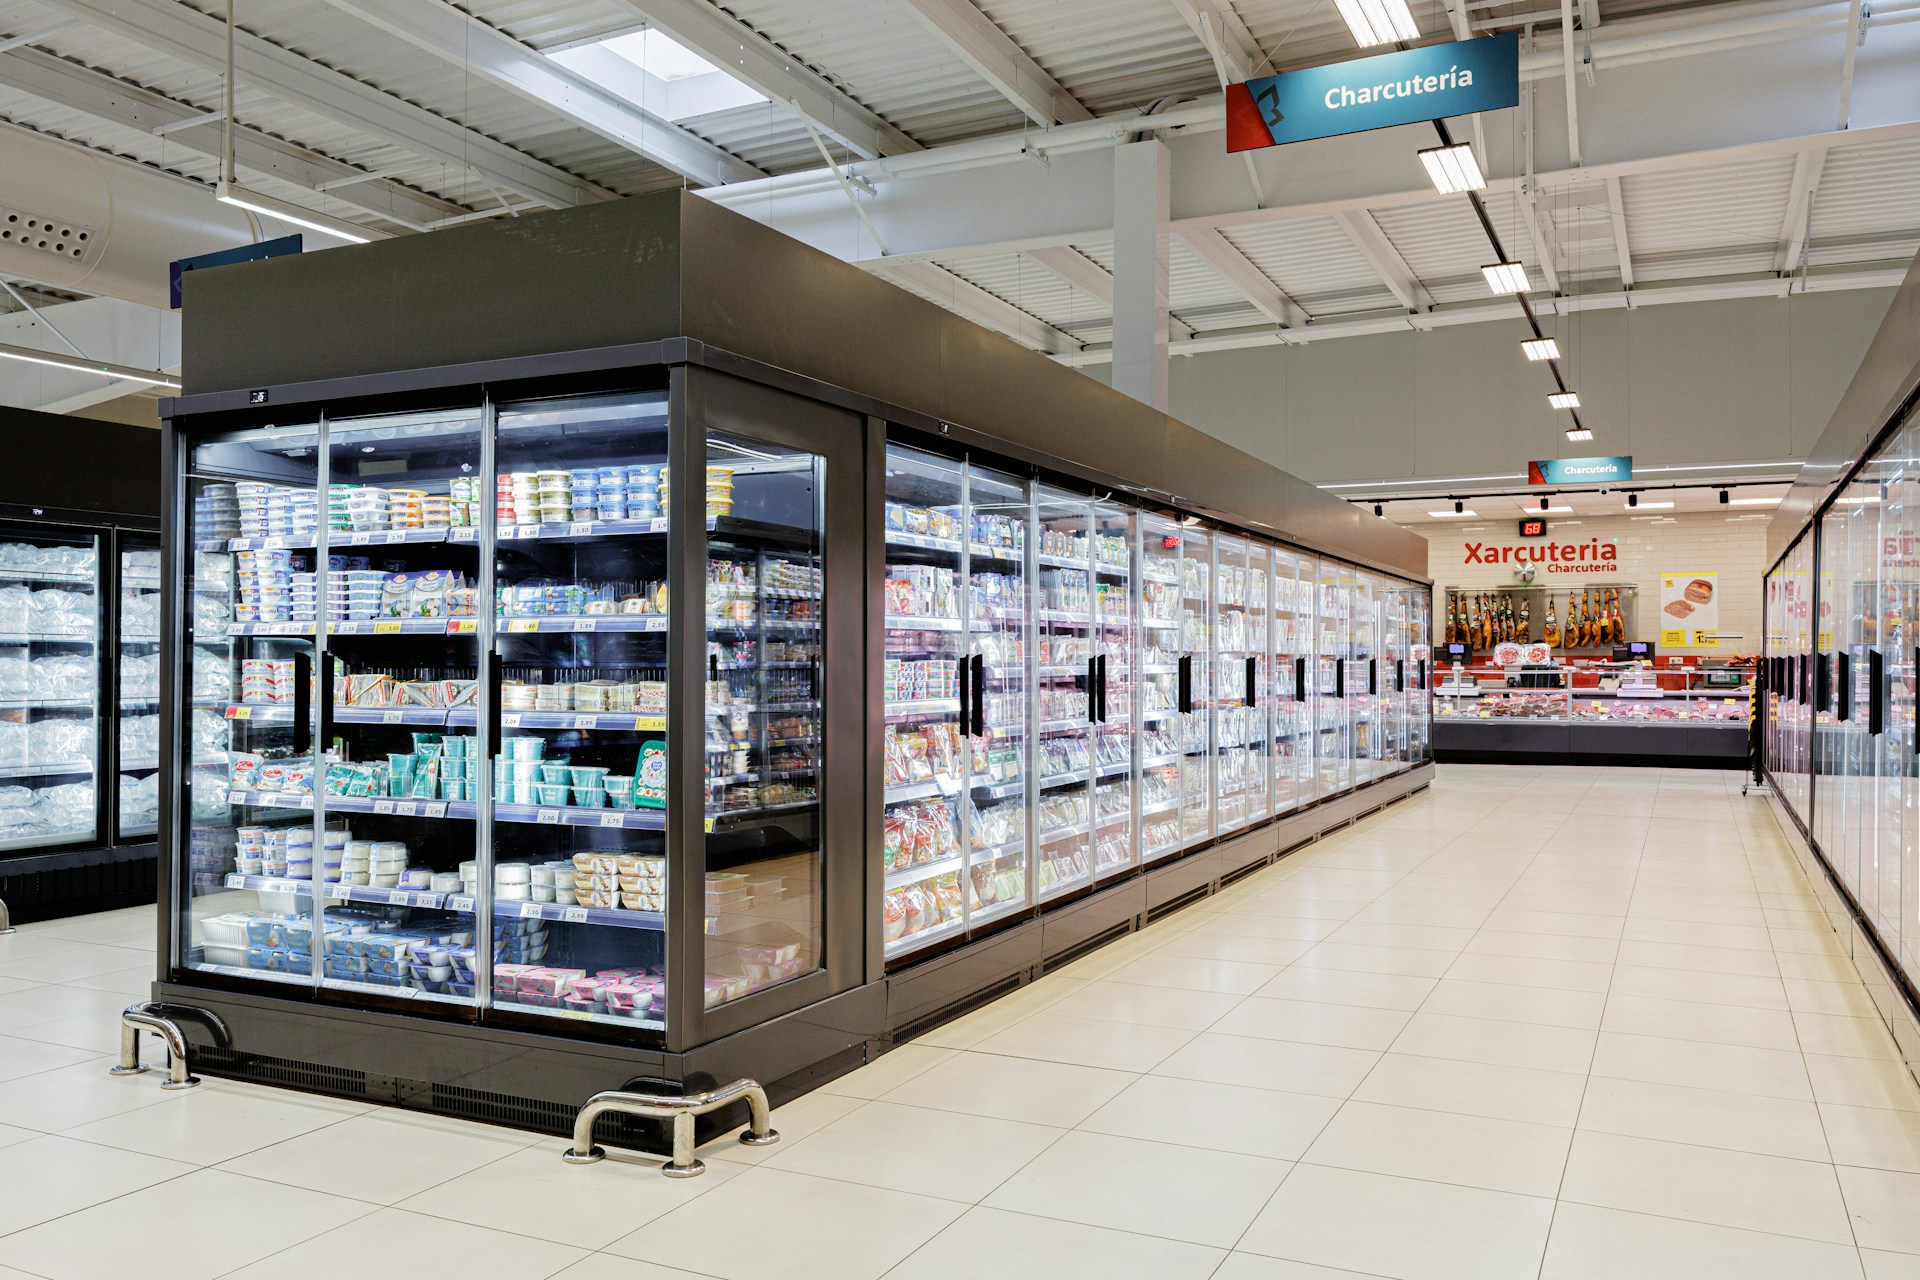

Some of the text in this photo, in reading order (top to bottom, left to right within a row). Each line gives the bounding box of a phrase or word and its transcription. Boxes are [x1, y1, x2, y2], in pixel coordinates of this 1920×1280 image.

[1324, 65, 1473, 109] Charcutería
[1564, 464, 1618, 475] Charcutería
[1524, 523, 1541, 535] 68
[1464, 538, 1617, 564] Xarcuteria
[1547, 562, 1617, 573] Charcutería
